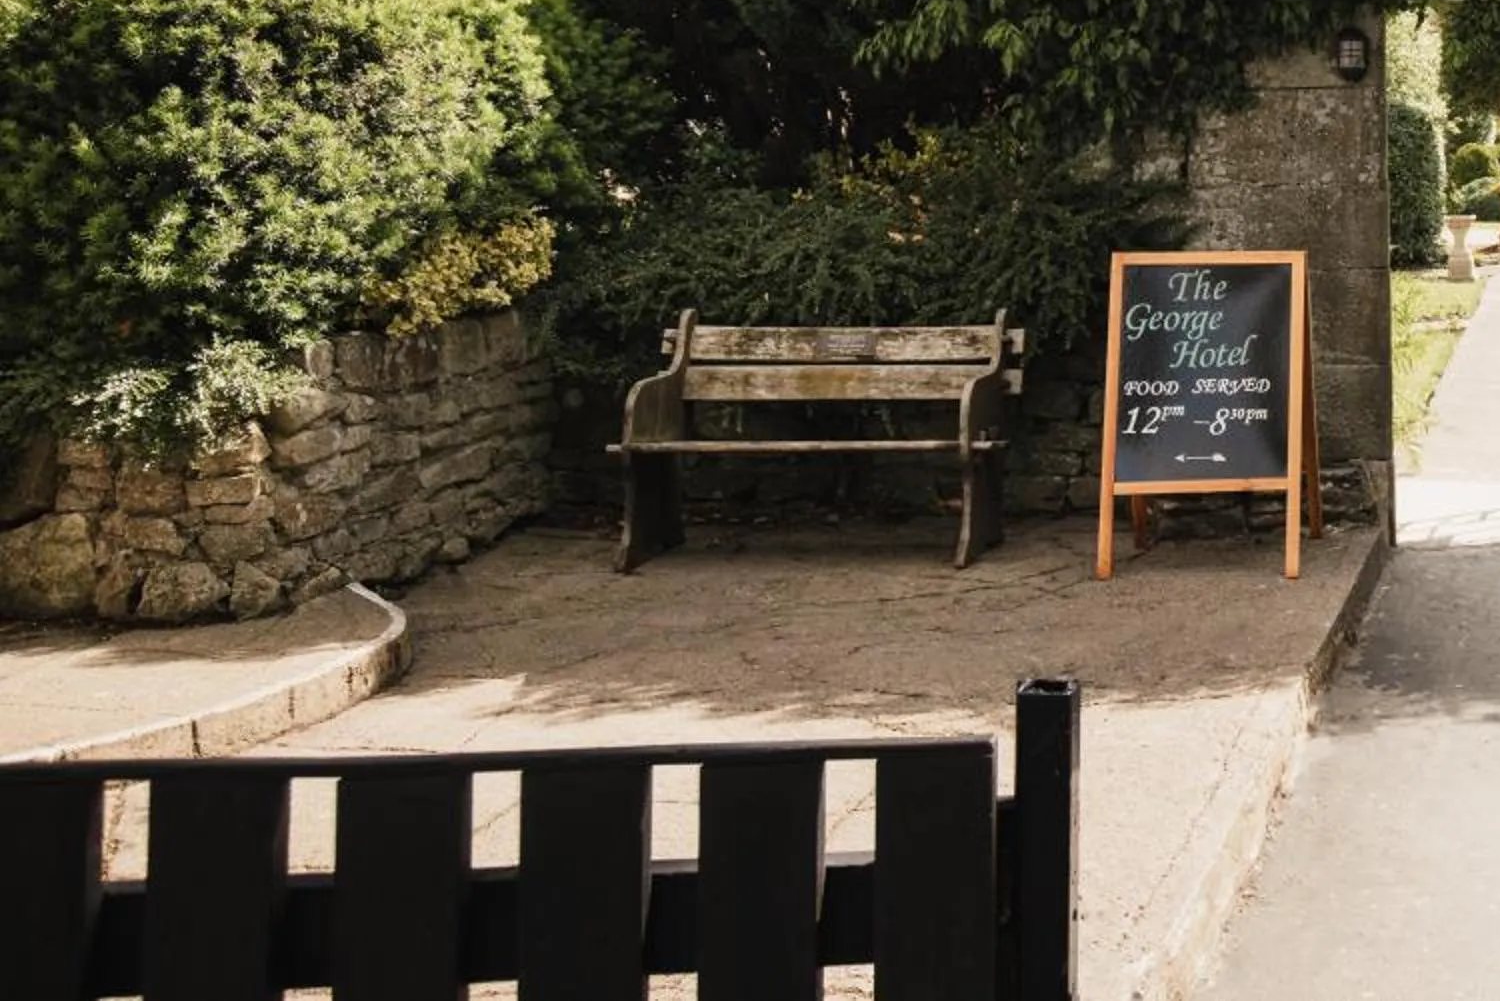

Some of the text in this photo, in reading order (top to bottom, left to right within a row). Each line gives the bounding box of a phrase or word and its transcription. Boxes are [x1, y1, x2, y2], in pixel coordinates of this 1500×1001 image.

[1168, 269, 1227, 302] The
[1125, 303, 1223, 340] George
[1169, 334, 1257, 369] Hotel
[1123, 378, 1271, 396] FOOD SERVED
